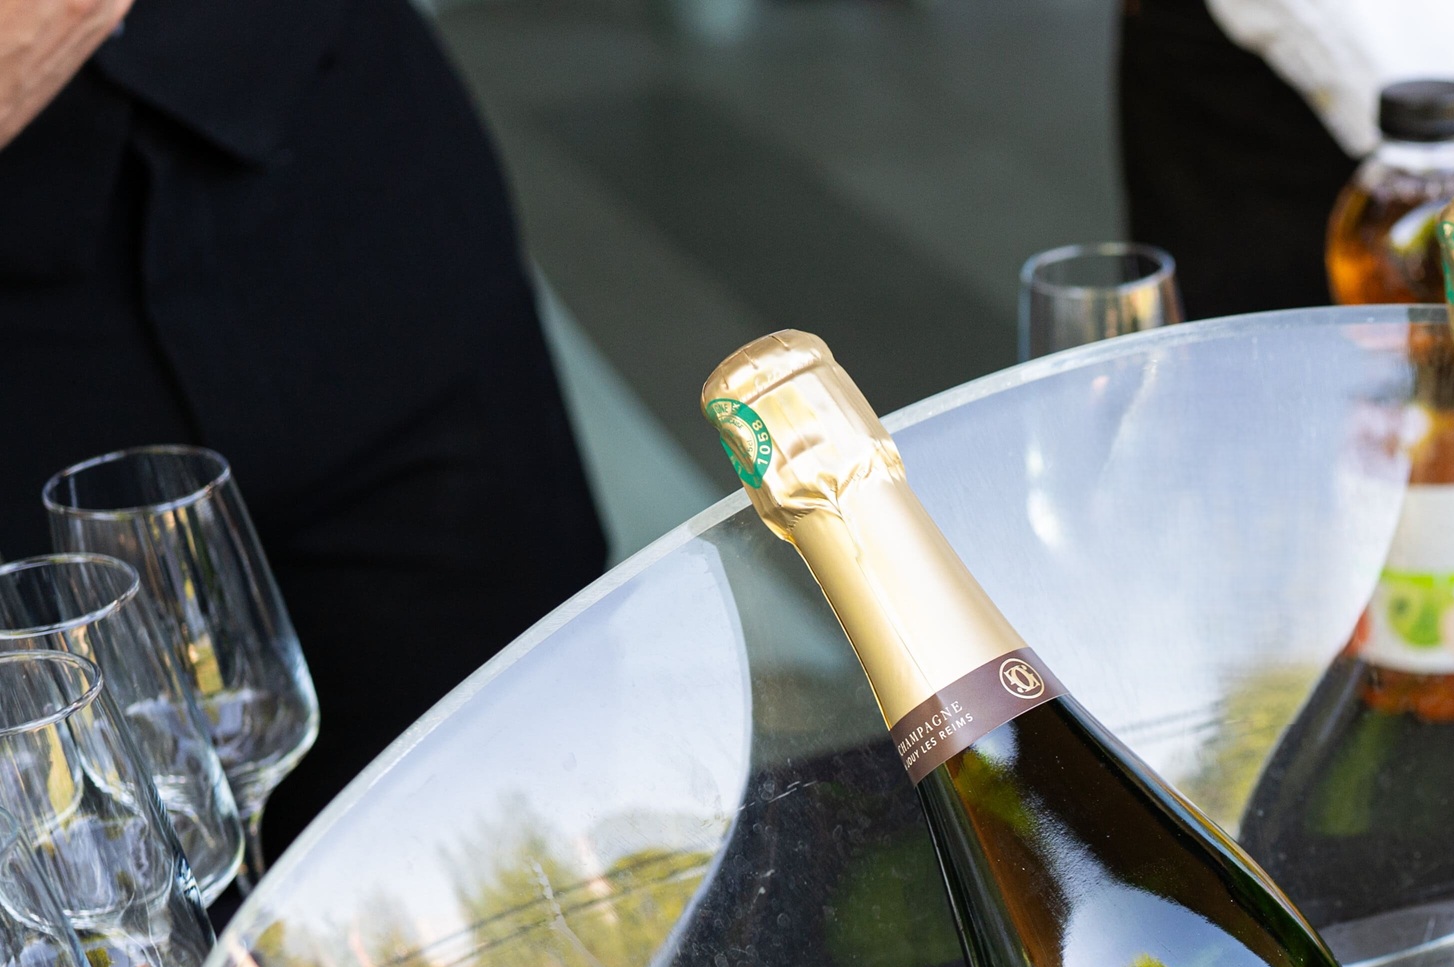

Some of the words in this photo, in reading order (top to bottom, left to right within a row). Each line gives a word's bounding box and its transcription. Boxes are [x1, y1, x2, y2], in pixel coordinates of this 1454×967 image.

[752, 420, 770, 465] 1058
[898, 701, 962, 756] CHAMPAGNE
[922, 737, 937, 754] LES
[939, 712, 973, 740] REIMS
